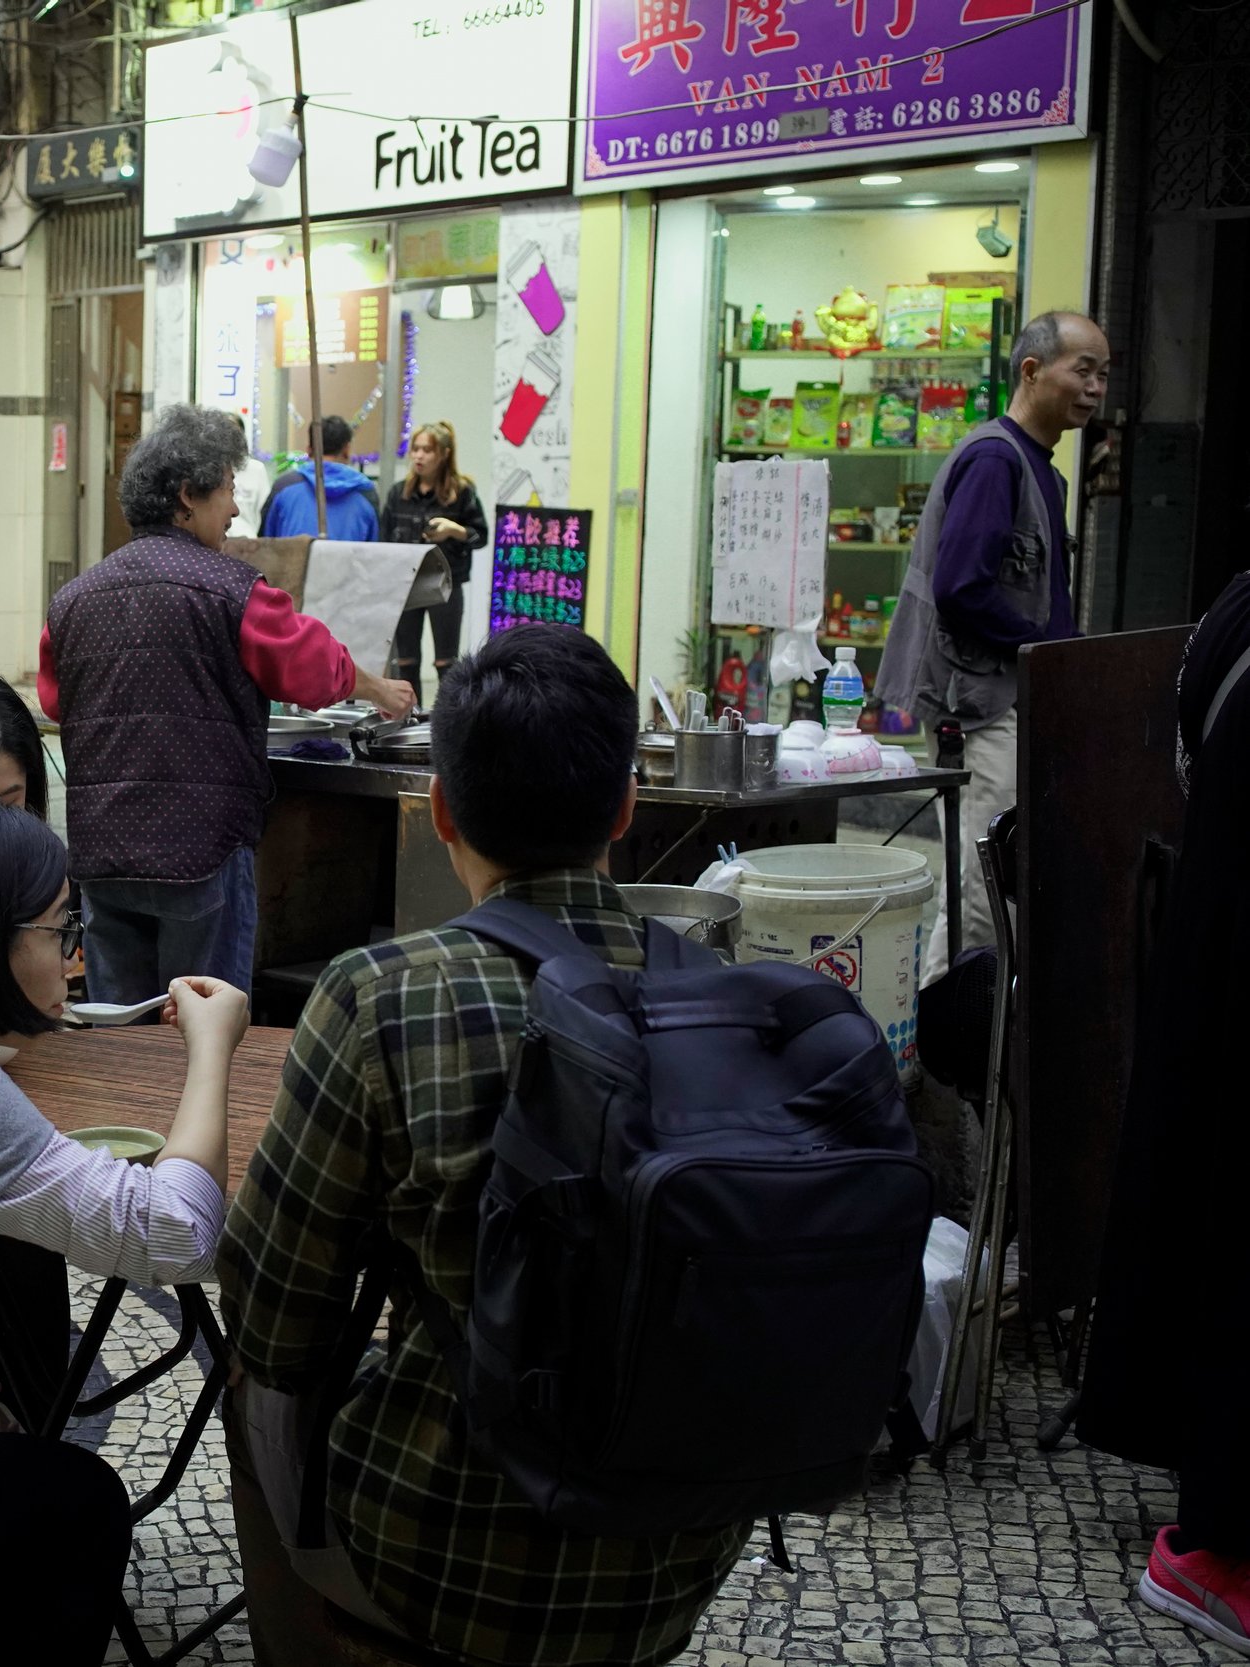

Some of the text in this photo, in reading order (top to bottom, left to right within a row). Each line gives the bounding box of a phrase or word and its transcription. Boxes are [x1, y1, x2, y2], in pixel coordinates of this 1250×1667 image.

[687, 47, 945, 117] VAN NAM 2
[375, 115, 542, 190] Fruit Tea
[607, 136, 649, 163] DT:
[655, 127, 713, 156] 6676
[720, 118, 781, 148] 1899
[892, 97, 960, 128] 6286
[969, 88, 1042, 119] 3886
